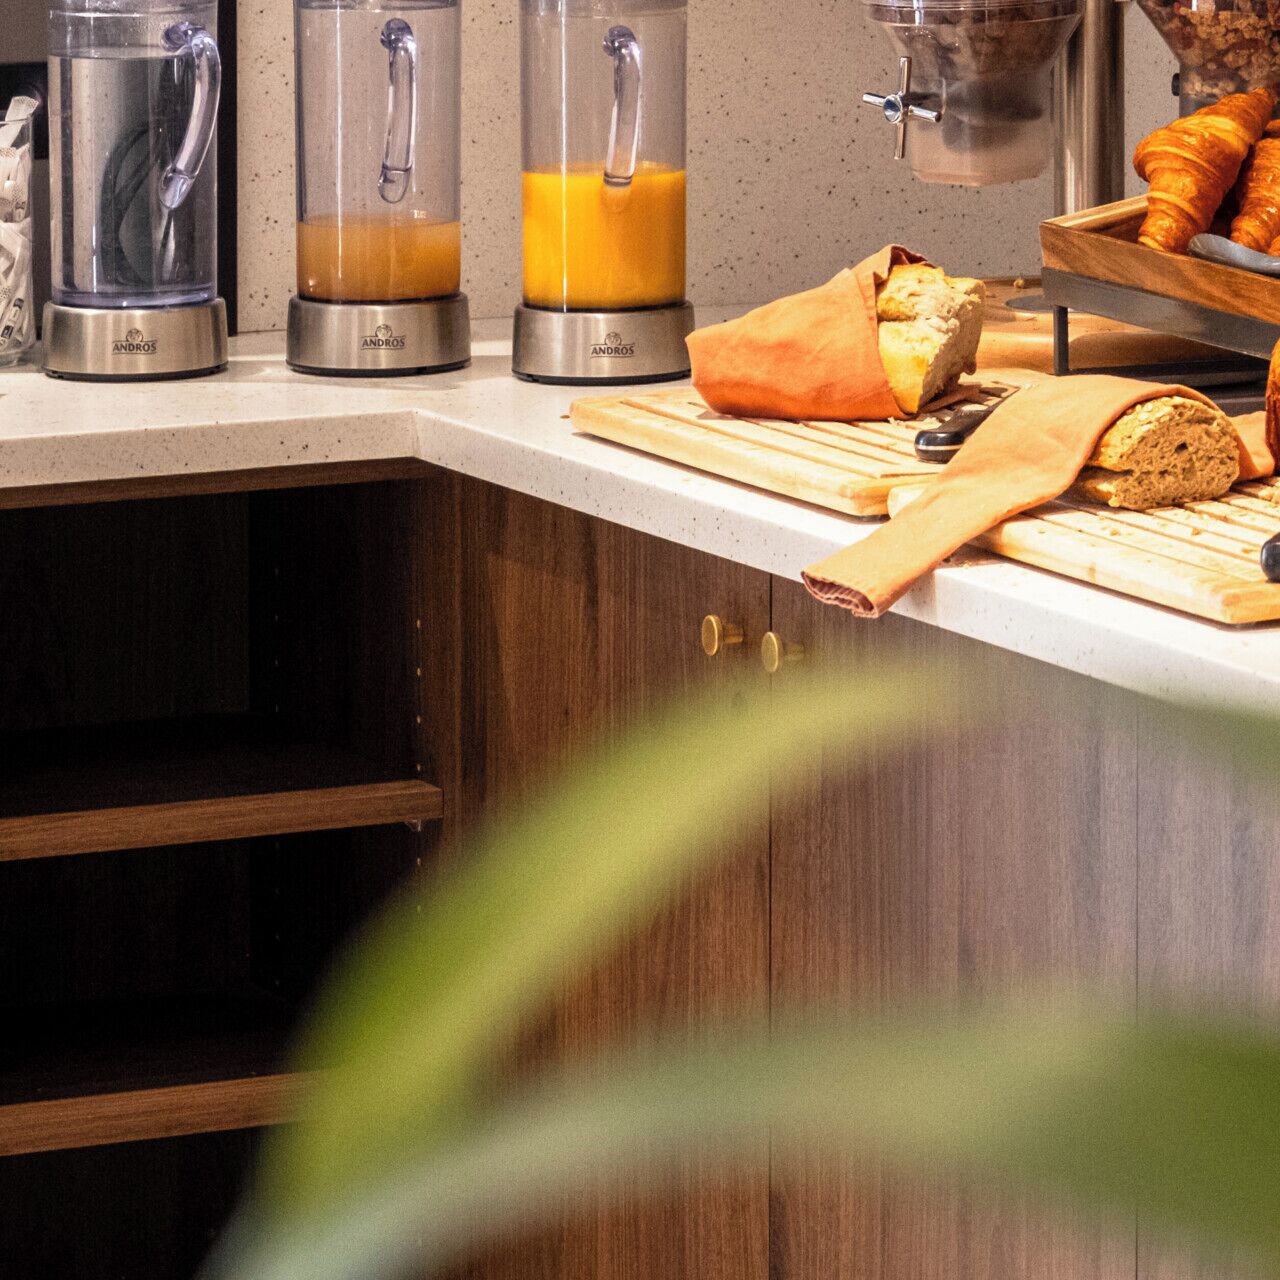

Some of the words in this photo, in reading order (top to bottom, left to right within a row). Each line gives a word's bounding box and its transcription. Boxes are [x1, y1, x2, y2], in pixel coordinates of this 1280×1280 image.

[113, 342, 157, 352] ANDROS
[362, 338, 406, 348] ANDROS
[591, 345, 635, 355] ANDROS
